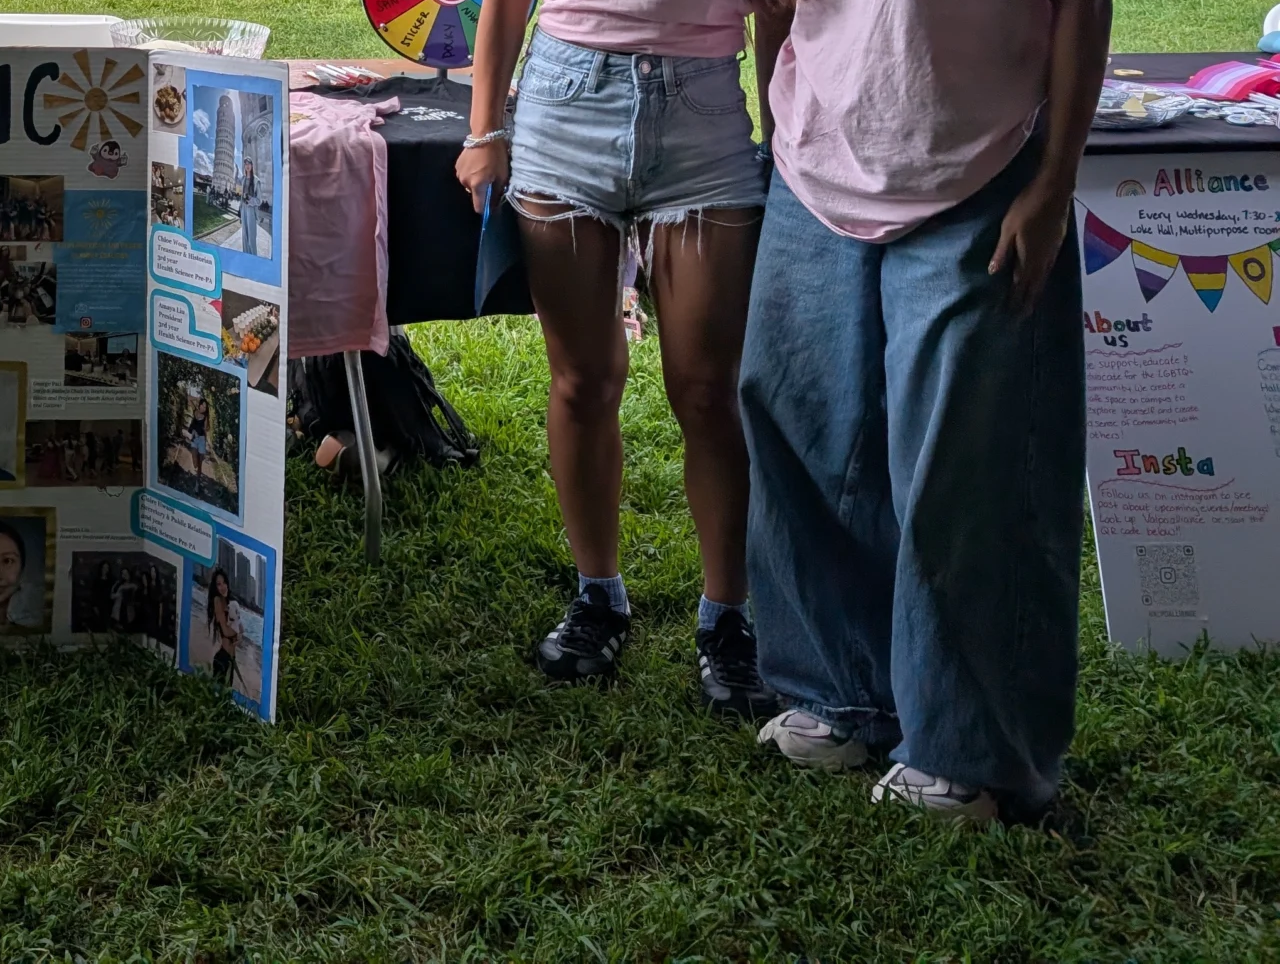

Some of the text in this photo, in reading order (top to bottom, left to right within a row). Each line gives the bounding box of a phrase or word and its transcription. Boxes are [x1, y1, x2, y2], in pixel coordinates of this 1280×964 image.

[400, 10, 430, 48] STICKER
[442, 23, 457, 59] POCKY
[1153, 168, 1270, 197] Alliance
[1138, 209, 1172, 224] Every
[1179, 225, 1249, 238] Multipurpose
[157, 235, 188, 250] Chloe Wong
[157, 244, 182, 257] Treasurer
[188, 252, 213, 266] Historian
[157, 254, 179, 266] 3rd year
[157, 263, 213, 285] Health Science Pre-PA
[158, 311, 183, 323] President
[1083, 310, 1154, 334] About
[167, 324, 179, 332] year
[158, 330, 215, 352] Health Science Pre-PA
[1103, 334, 1129, 348] us
[1124, 369, 1138, 380] for
[1142, 370, 1155, 380] the
[1150, 382, 1176, 392] create
[1105, 396, 1127, 405] space
[1140, 396, 1172, 406] campus
[1174, 394, 1186, 402] to
[1121, 405, 1156, 419] yourself
[1112, 446, 1216, 477] Insta
[1101, 488, 1133, 500] Follow
[1138, 491, 1151, 500] us
[1155, 491, 1168, 501] on
[1220, 490, 1232, 500] to
[1233, 491, 1252, 500] see
[1097, 500, 1118, 511] post
[1122, 502, 1151, 512] about
[140, 504, 166, 520] Secretary
[171, 516, 187, 528] Public
[188, 523, 212, 539] Relations
[152, 517, 163, 526] year
[1099, 514, 1122, 524] Look
[1124, 515, 1137, 527] up
[141, 522, 158, 533] Health
[159, 530, 177, 541] Science
[1100, 526, 1117, 536] QR
[1120, 526, 1142, 536] code
